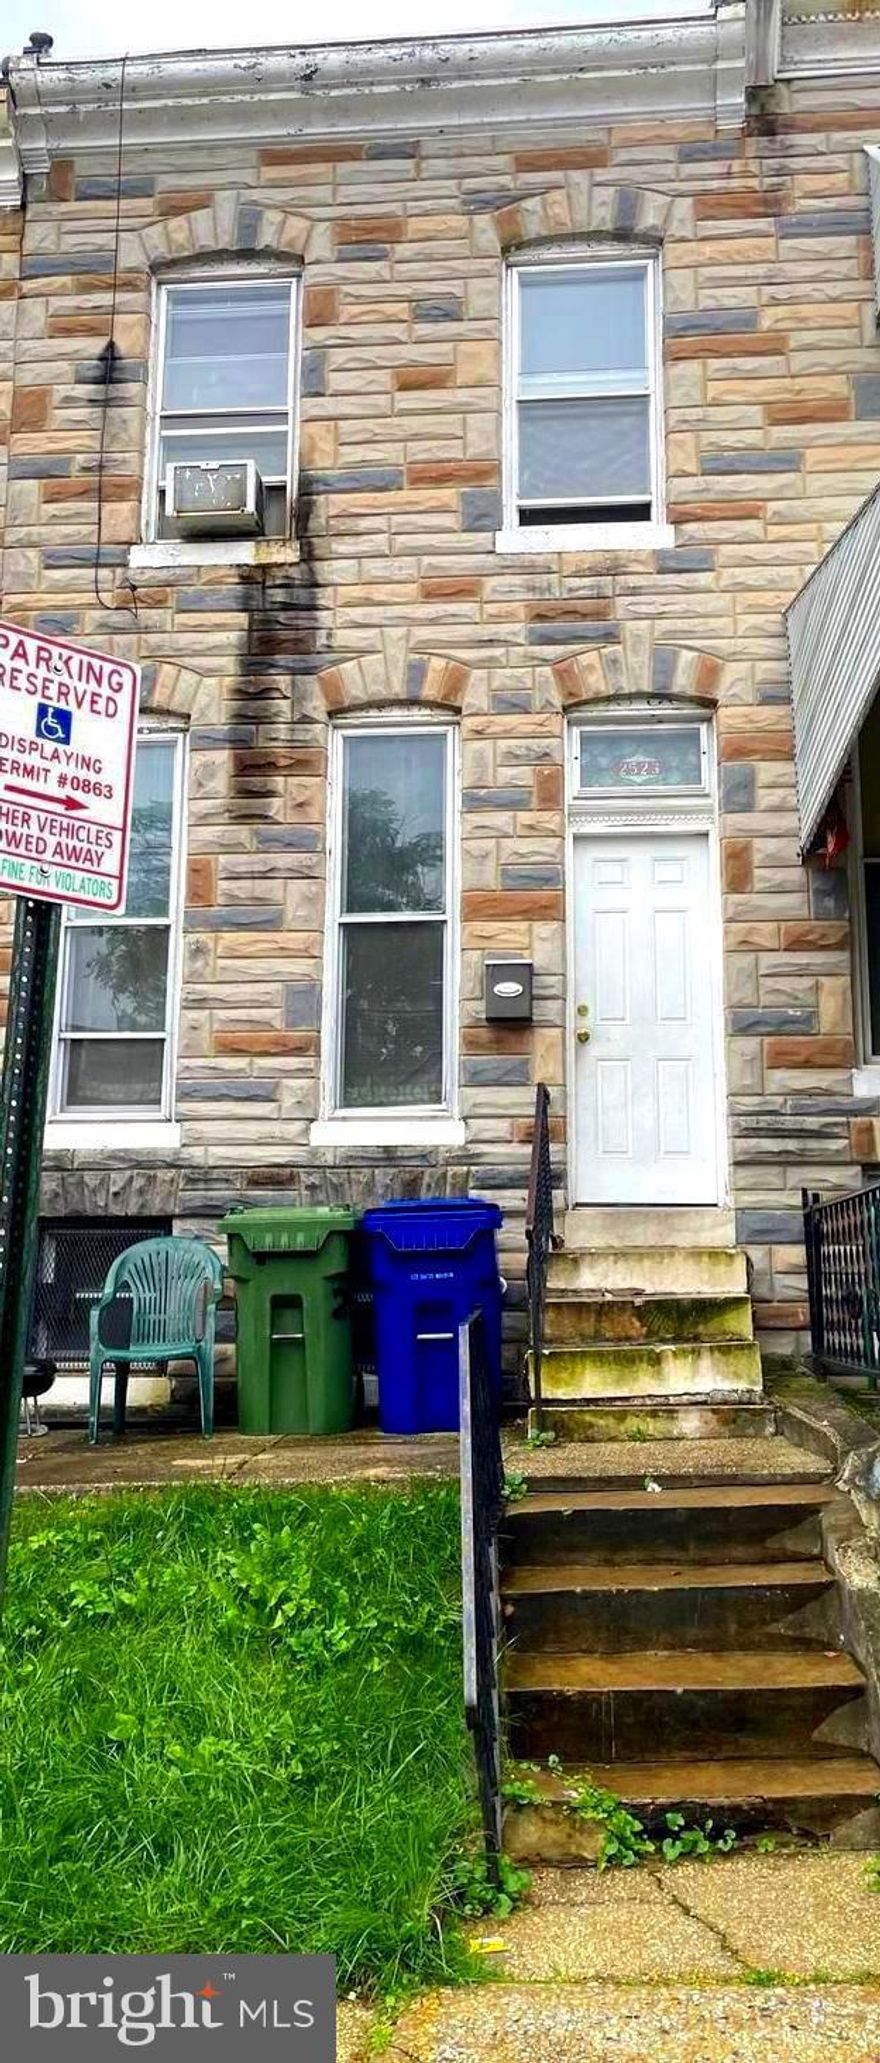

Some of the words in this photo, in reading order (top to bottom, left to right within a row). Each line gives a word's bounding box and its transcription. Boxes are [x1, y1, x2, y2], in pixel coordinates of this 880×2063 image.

[0, 632, 124, 694] PARKING
[0, 731, 103, 775] DISPLAYING
[57, 772, 114, 800] #0863
[0, 828, 48, 855] WED
[51, 841, 105, 868] AWAY
[37, 813, 114, 850] VEHICLES
[1, 857, 26, 882] FINE
[28, 864, 51, 888] FOR
[54, 870, 114, 900] VIOLATORS
